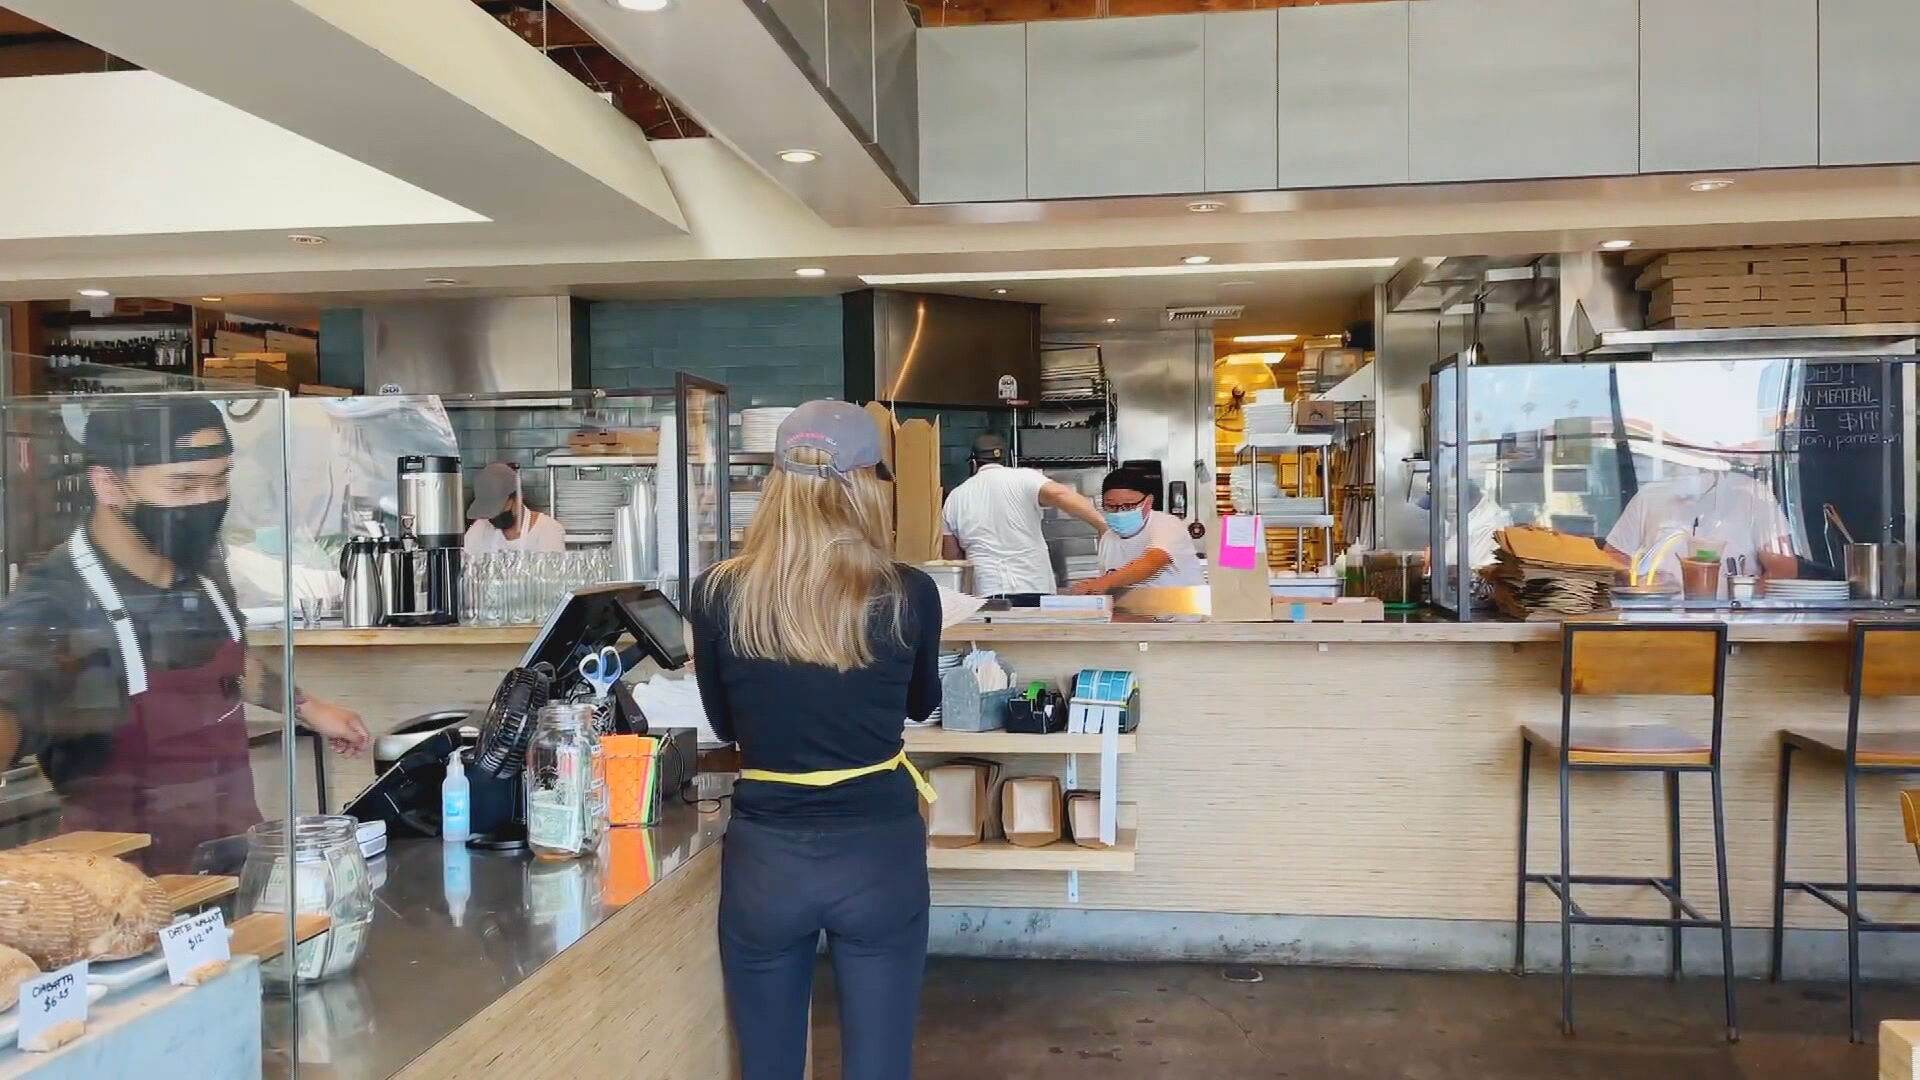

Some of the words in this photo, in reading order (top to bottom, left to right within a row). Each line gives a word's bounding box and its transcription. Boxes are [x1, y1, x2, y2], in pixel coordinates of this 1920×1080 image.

[1817, 385, 1880, 406] MEATBAL
[1836, 433, 1901, 452] parmean
[167, 923, 193, 940] DATE
